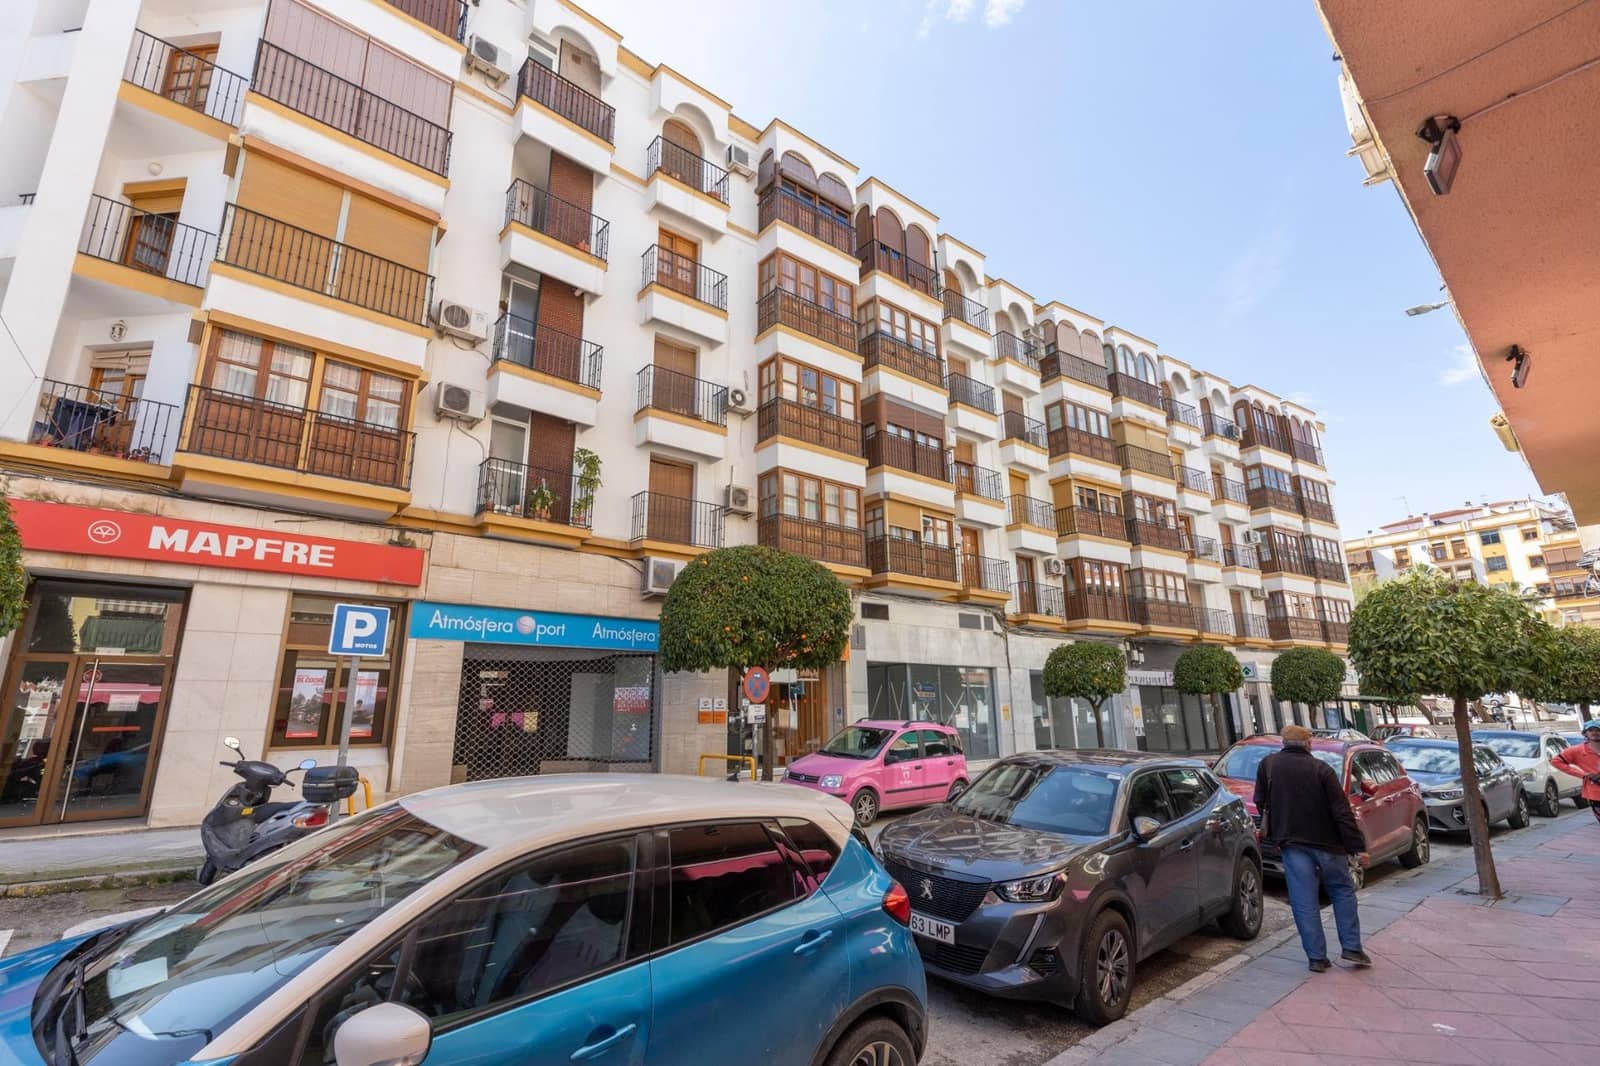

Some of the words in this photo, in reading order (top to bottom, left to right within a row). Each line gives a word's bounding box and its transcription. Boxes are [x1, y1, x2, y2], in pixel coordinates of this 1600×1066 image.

[148, 525, 336, 568] MAPFRE
[342, 611, 377, 649] P
[429, 609, 513, 638] Atmósfera
[592, 622, 656, 647] Atmósfera
[928, 920, 951, 940] LMP
